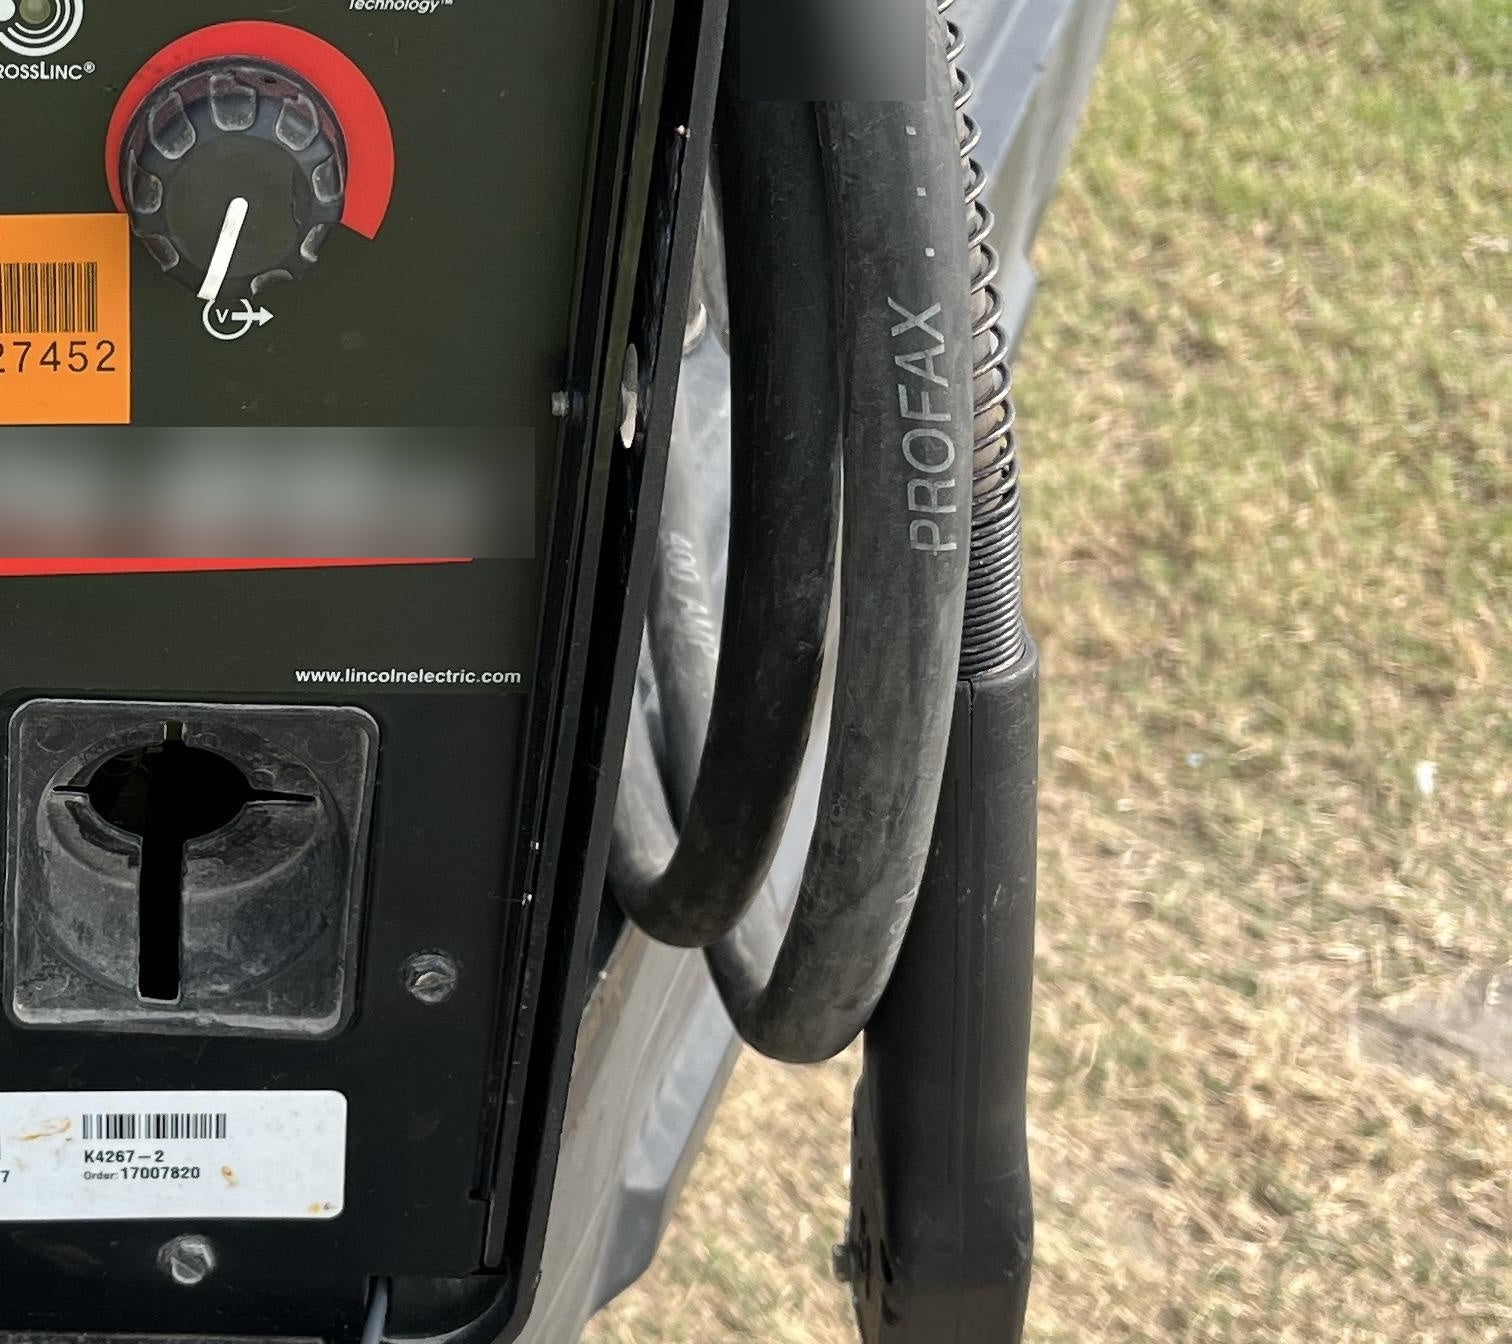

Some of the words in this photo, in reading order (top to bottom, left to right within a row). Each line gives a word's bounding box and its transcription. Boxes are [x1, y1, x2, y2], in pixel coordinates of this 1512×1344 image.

[887, 296, 957, 551] PROFAX
[295, 667, 522, 684] www.lincolnelectric.com
[121, 1166, 201, 1180] 17007820
